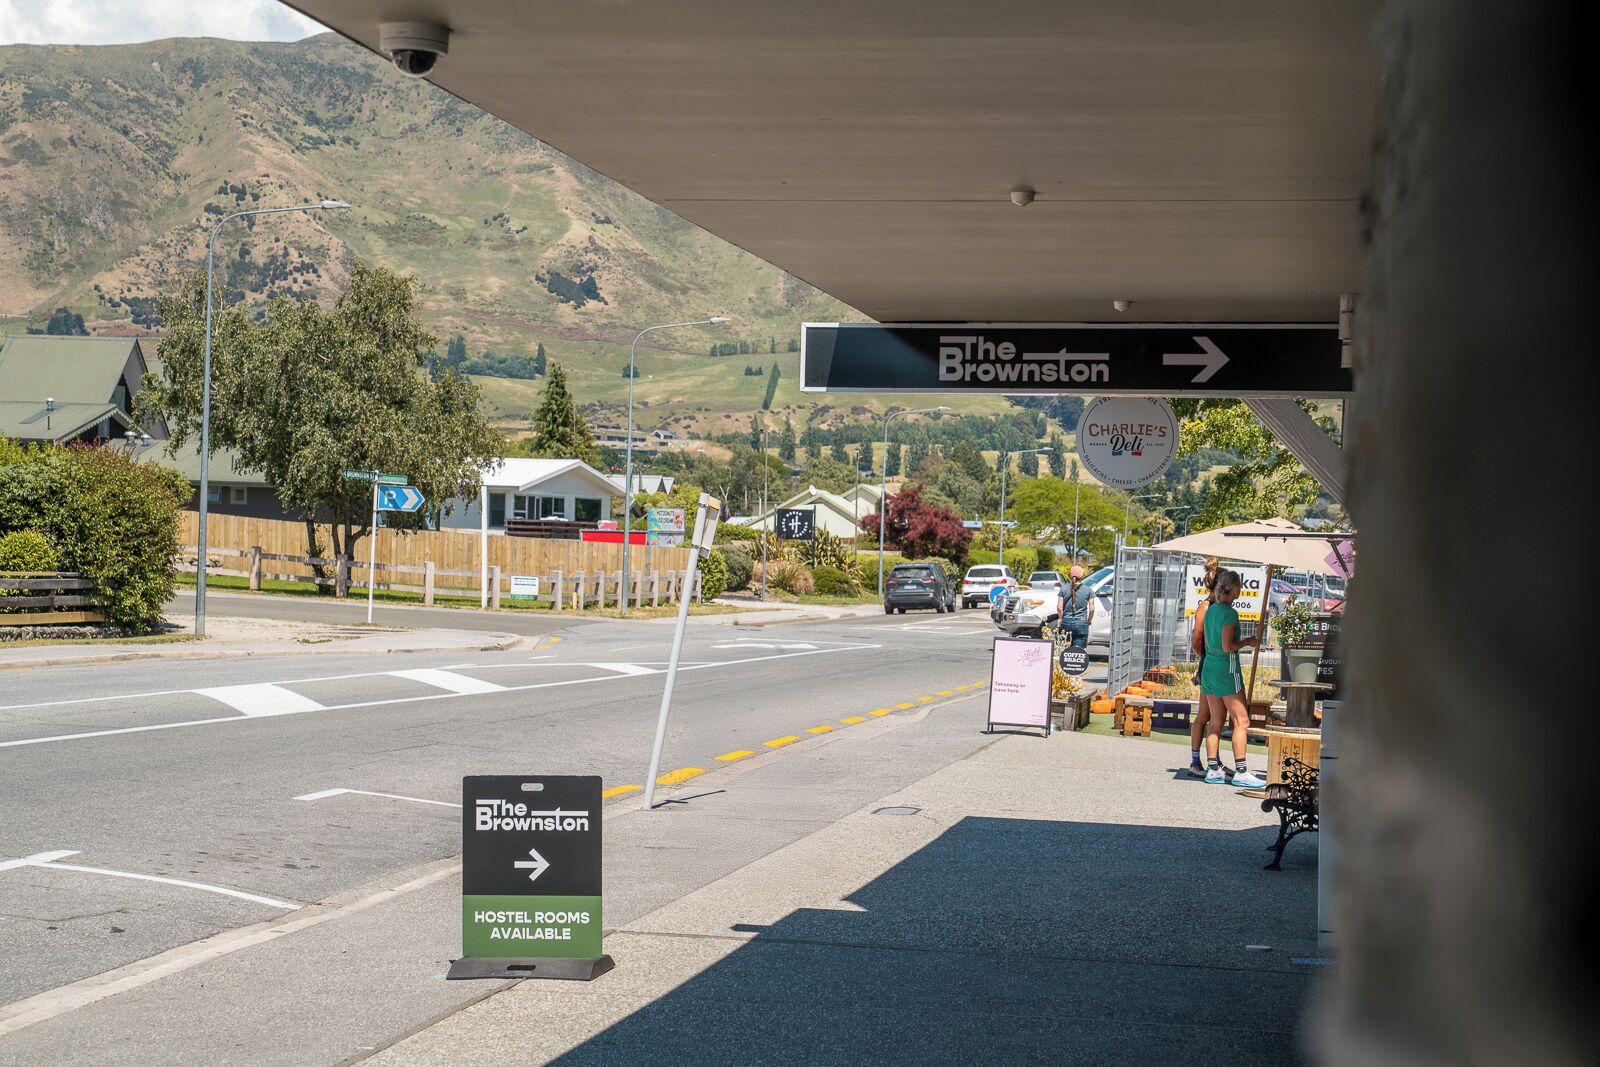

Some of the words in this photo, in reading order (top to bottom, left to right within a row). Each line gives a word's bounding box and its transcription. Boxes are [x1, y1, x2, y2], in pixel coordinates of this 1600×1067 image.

[939, 336, 1016, 361] The
[939, 346, 1110, 382] Brownston
[1088, 423, 1167, 437] CHARLIE'S
[1110, 433, 1144, 452] Deli
[1084, 454, 1108, 480] DELICACIES
[1137, 455, 1171, 483] CHARCUTERIES
[476, 799, 527, 817] The
[476, 806, 589, 831] Brownston
[474, 911, 532, 923] HOSTEL
[535, 911, 590, 924] ROOMS
[490, 927, 571, 940] AVAILABLE
